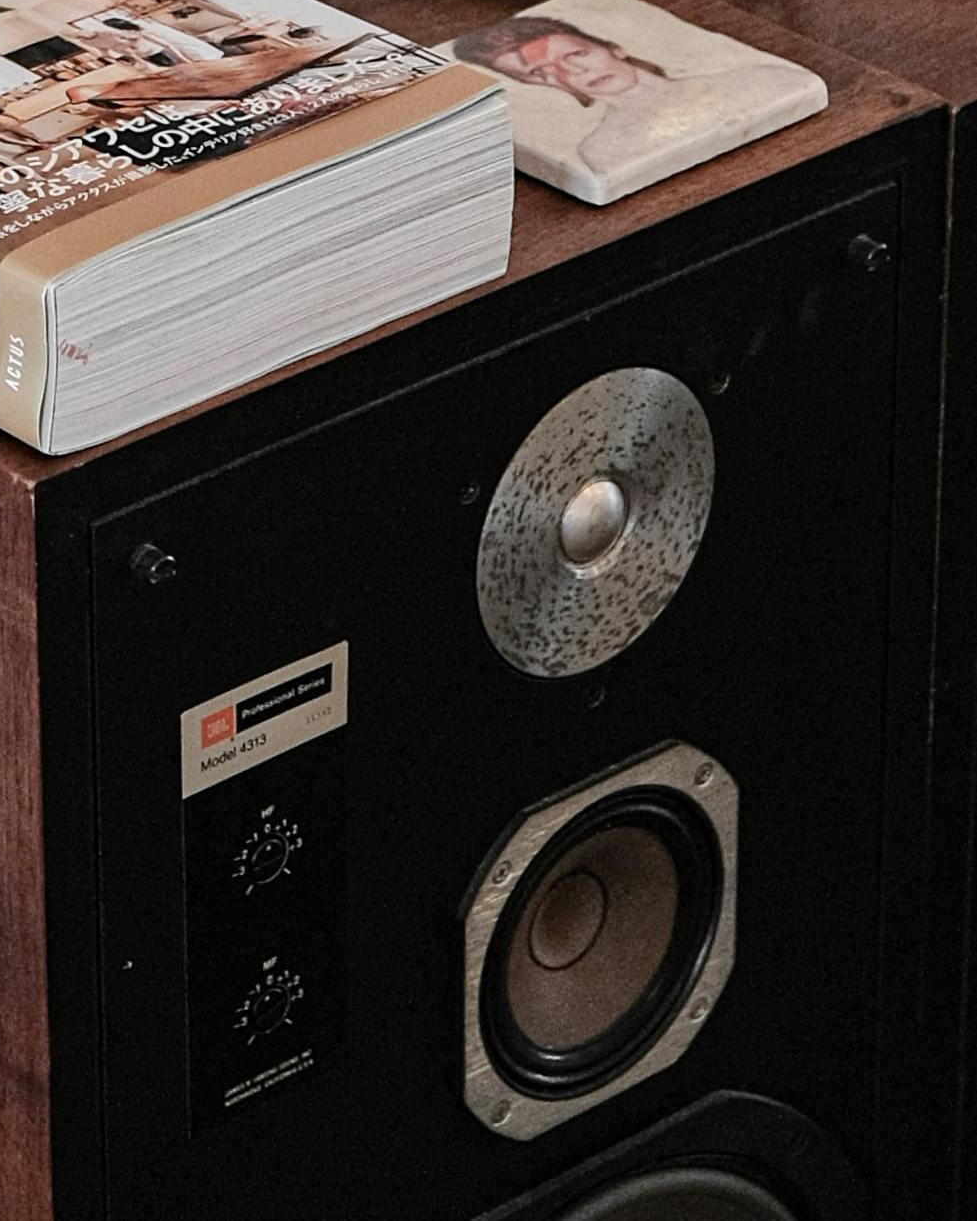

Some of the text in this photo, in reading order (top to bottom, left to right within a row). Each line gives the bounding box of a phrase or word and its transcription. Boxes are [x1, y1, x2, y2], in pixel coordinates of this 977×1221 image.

[7, 335, 25, 393] ACTUS
[241, 677, 325, 720] Professional Series
[200, 733, 267, 772] Model 4313
